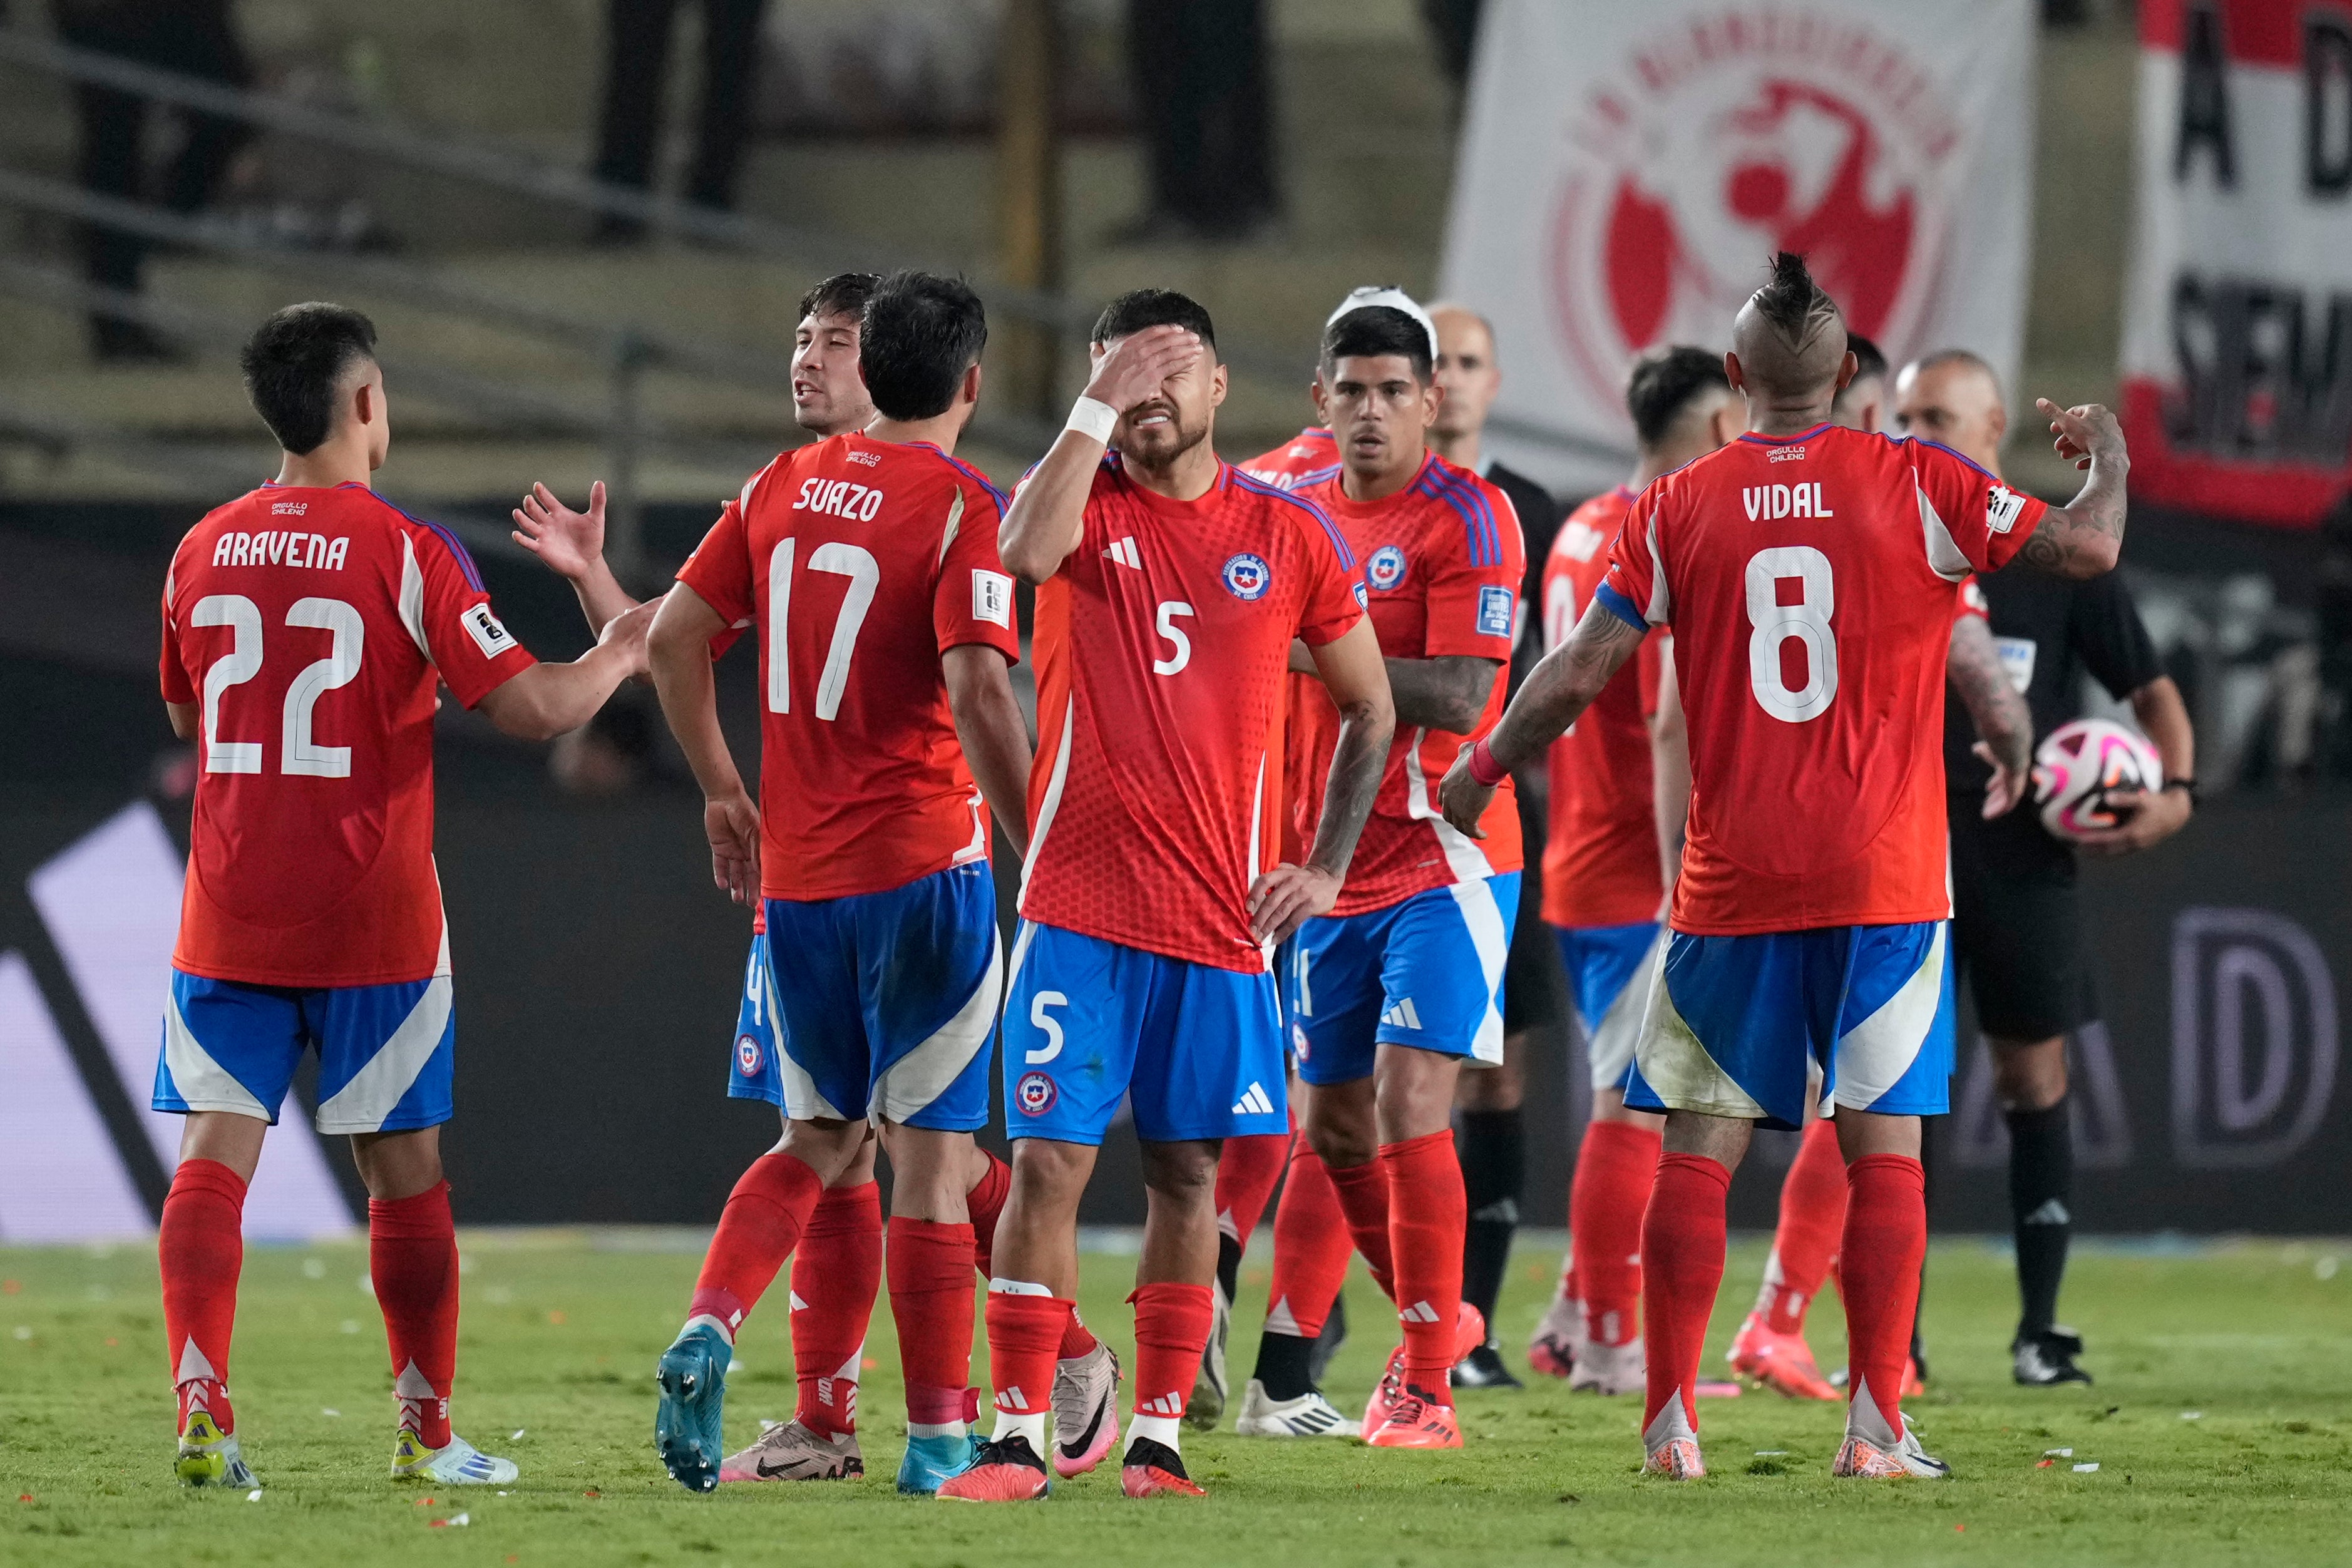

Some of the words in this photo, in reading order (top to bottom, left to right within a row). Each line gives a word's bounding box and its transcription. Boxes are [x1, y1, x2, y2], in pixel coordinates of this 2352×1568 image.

[1766, 446, 1805, 457] ORGULLO
[1769, 453, 1805, 463] CHILENO
[271, 508, 305, 516] CHILENO
[792, 477, 883, 523] SUAZO
[1742, 483, 1834, 522] VIDAL
[212, 530, 350, 571] ARAVENA
[768, 537, 880, 721] 17
[1153, 600, 1194, 676] 5
[1745, 545, 1839, 724] 8
[190, 594, 365, 779] 22
[746, 951, 763, 1027] 4
[1025, 990, 1068, 1065] 5
